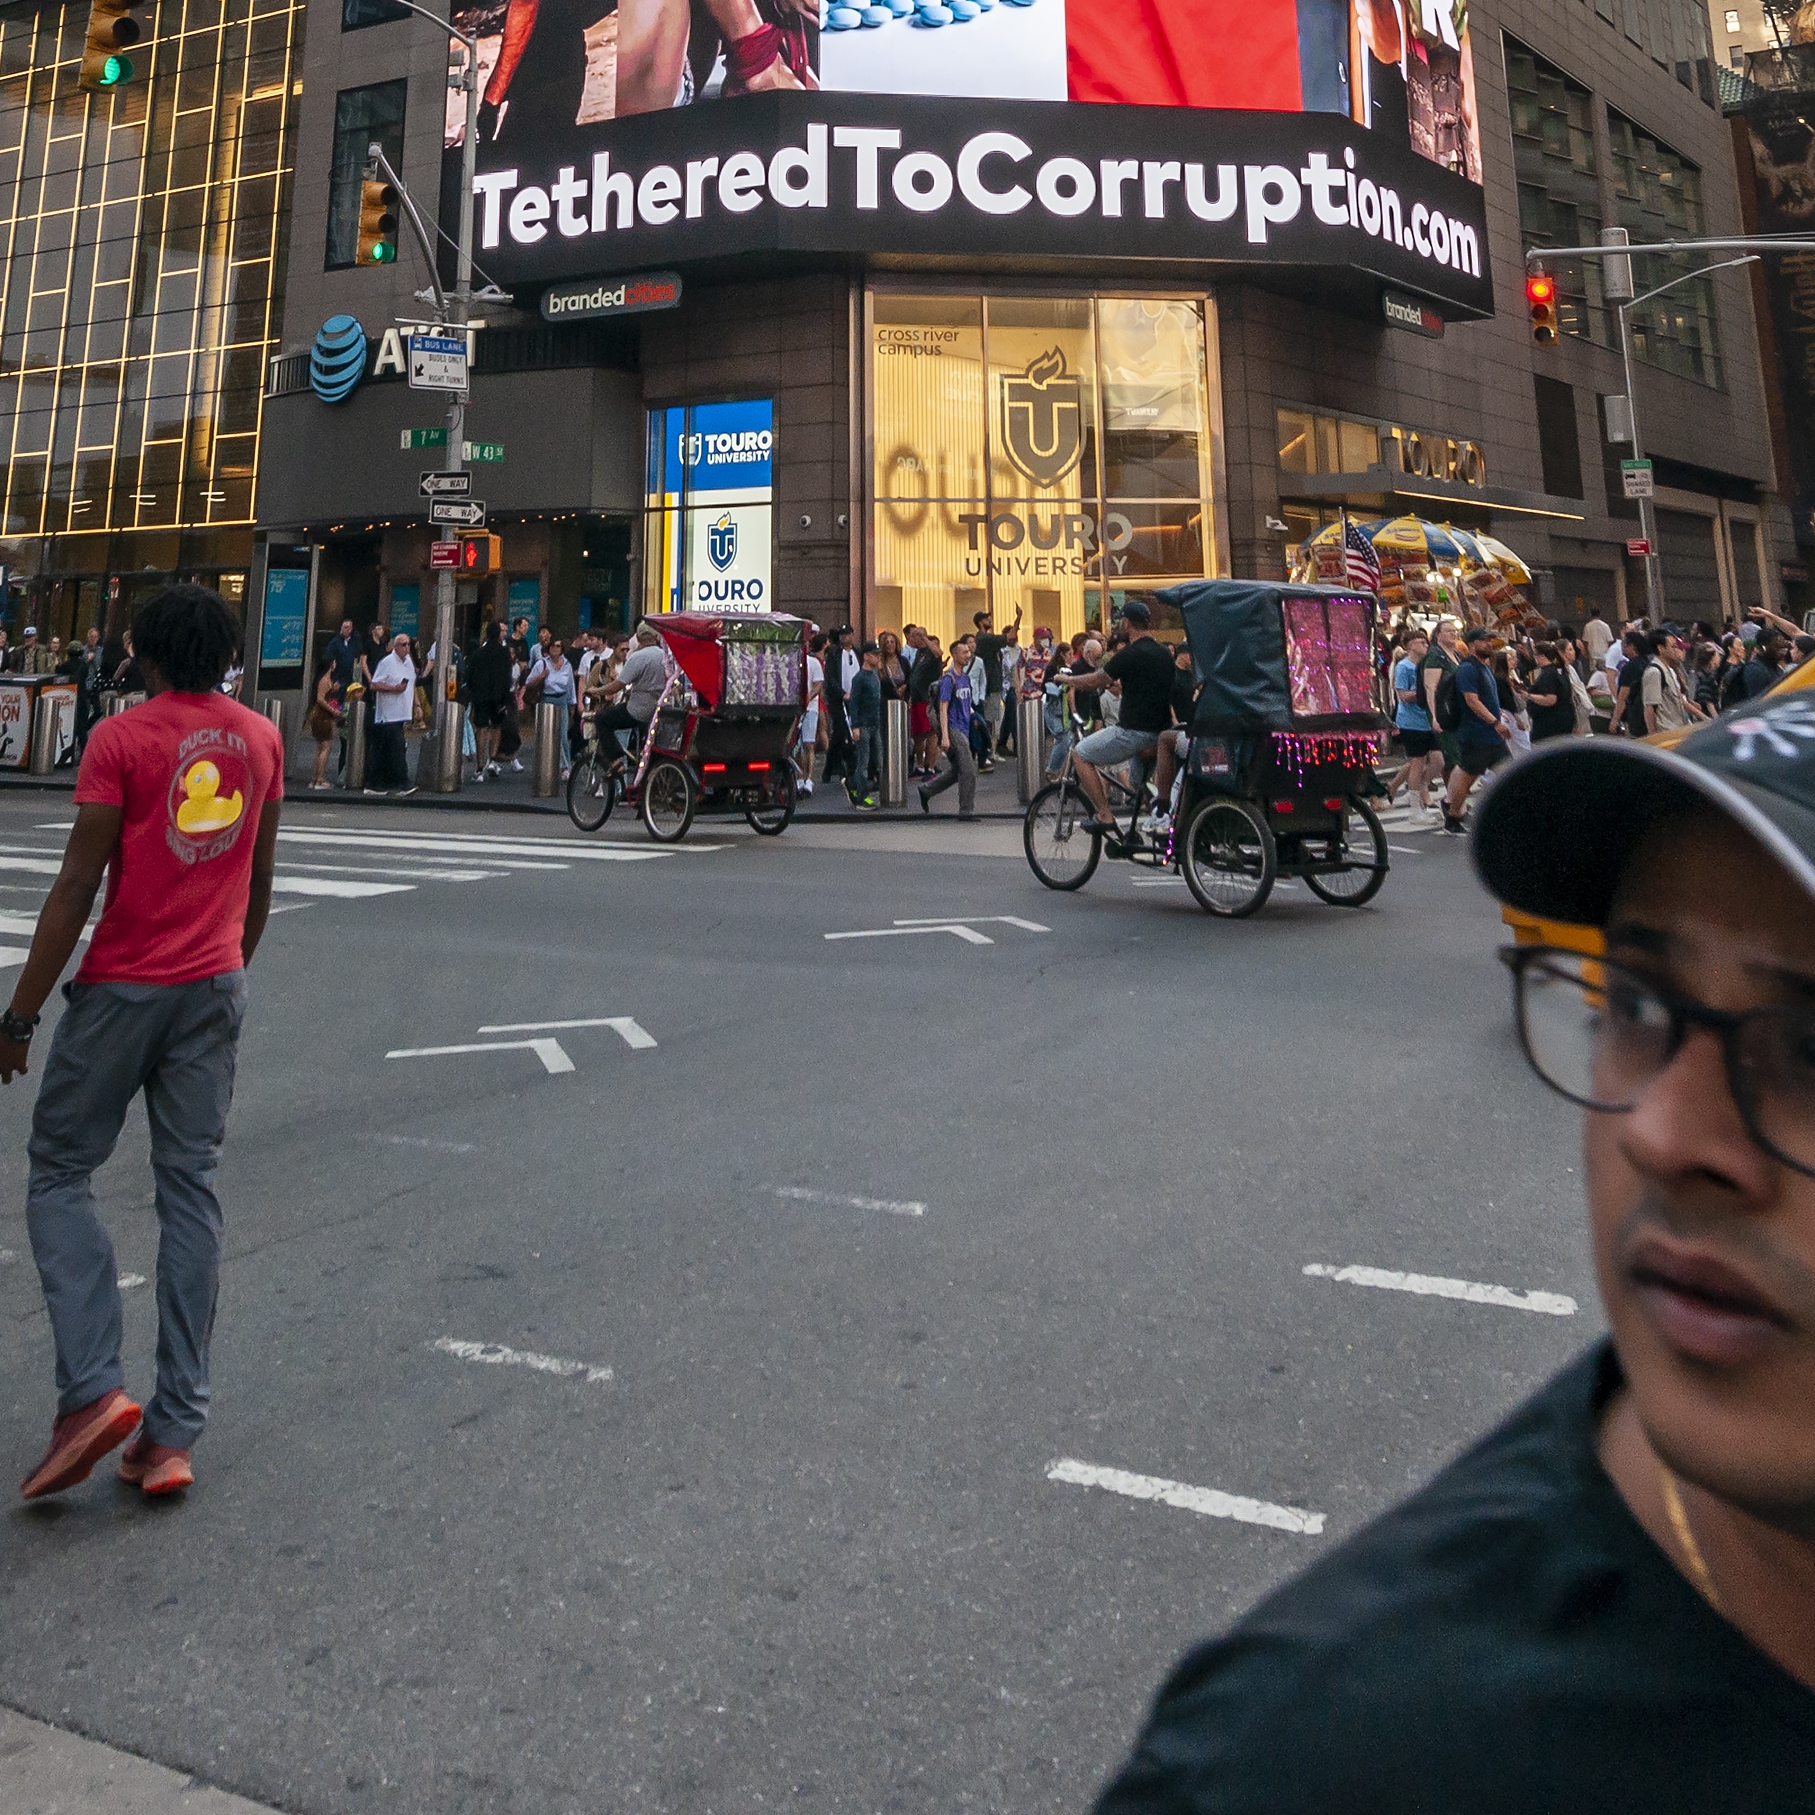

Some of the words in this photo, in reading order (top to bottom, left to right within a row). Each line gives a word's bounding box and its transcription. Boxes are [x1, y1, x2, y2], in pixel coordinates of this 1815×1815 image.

[472, 122, 1484, 278] TetheredToCorruption.com
[878, 328, 920, 342] cross
[922, 328, 959, 342] river
[373, 319, 486, 376] AT
[424, 340, 440, 350] BUS
[442, 341, 464, 352] LANE
[878, 342, 942, 358] campus
[704, 430, 772, 452] TOURO
[472, 445, 481, 460] W
[483, 445, 494, 461] 43
[707, 449, 771, 465] UNIVERSITY
[426, 479, 442, 489] ONE
[449, 479, 466, 489] WAY
[435, 506, 452, 516] ONE
[460, 508, 478, 518] WAY
[958, 512, 1134, 551] TOURO
[693, 578, 764, 602] OURO
